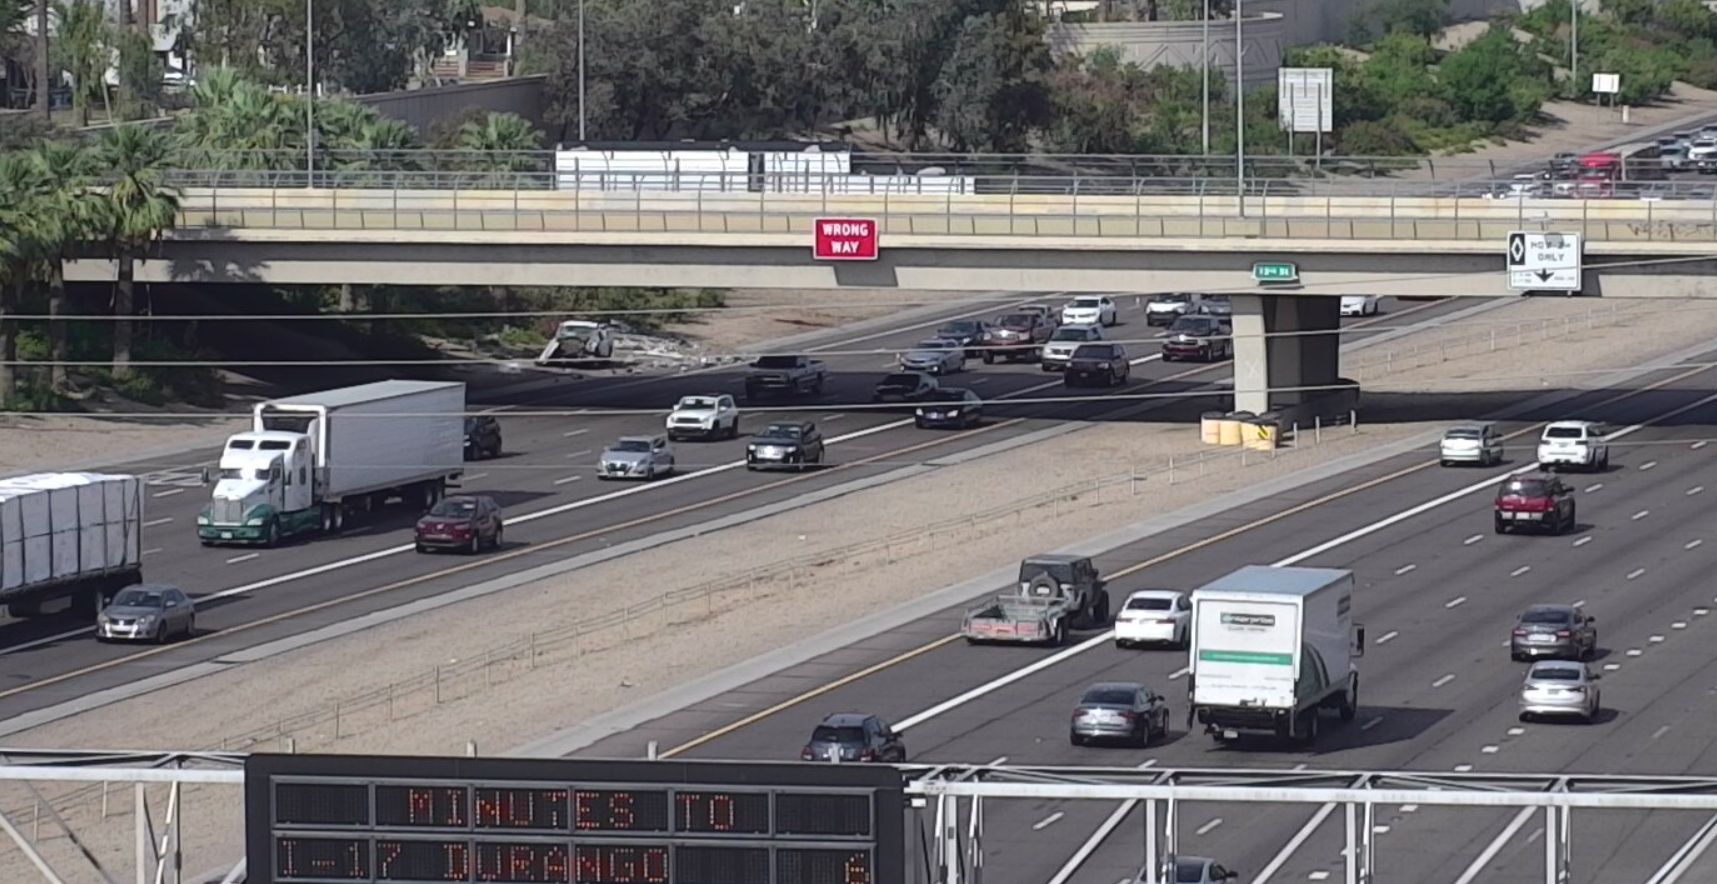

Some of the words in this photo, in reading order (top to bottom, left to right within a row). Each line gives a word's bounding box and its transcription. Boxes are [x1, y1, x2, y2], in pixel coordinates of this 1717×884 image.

[822, 223, 868, 236] WRONG
[831, 240, 859, 252] WAY
[1537, 253, 1564, 261] ONLY
[409, 788, 634, 828] MINUTES
[676, 793, 734, 829] TO
[282, 839, 402, 877] I-17
[443, 842, 668, 882] DURANGO
